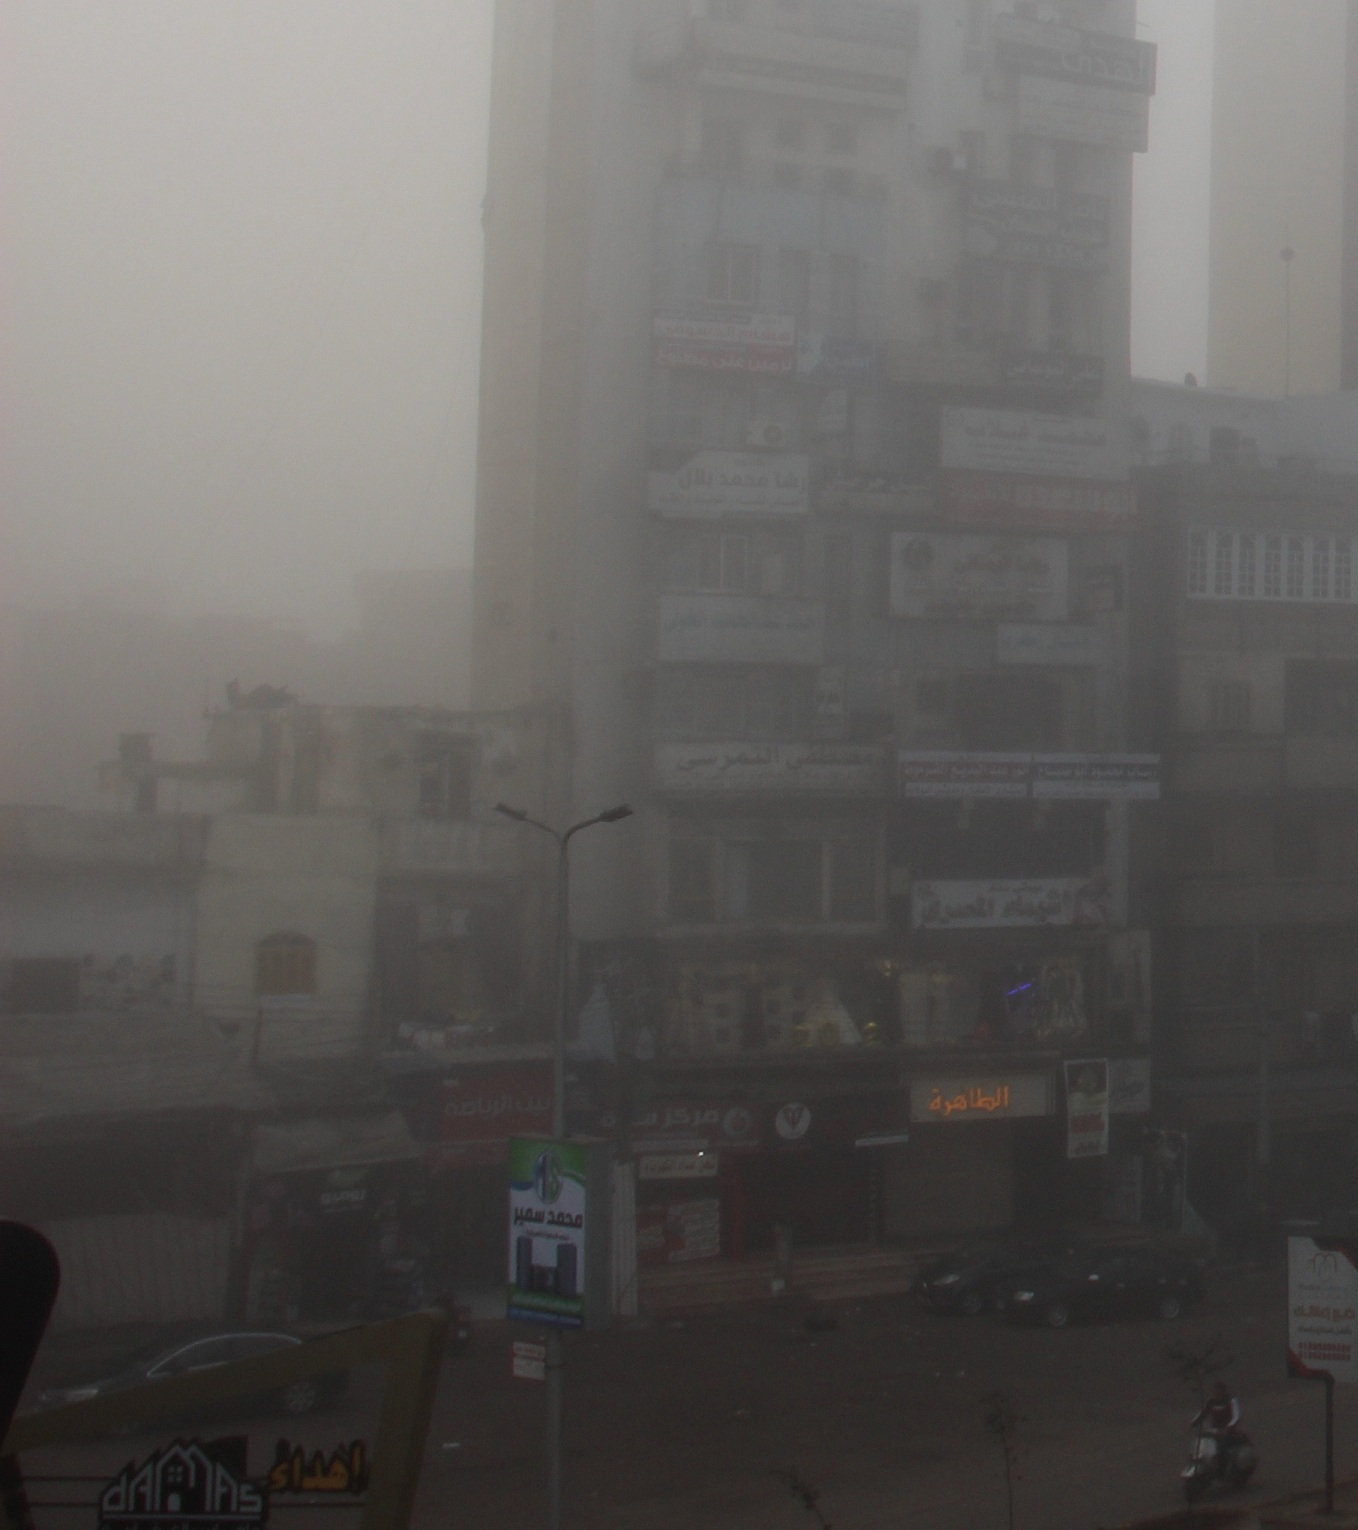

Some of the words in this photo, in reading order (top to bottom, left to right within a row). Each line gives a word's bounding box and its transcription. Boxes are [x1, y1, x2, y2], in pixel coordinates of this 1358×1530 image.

[711, 353, 745, 369] على
[719, 473, 769, 489] محمد
[443, 1094, 514, 1120] الرياضة
[929, 1085, 1010, 1116] الطاهرة
[660, 1106, 720, 1132] مركز
[513, 1207, 546, 1227] سمير
[547, 1211, 583, 1229] محمد
